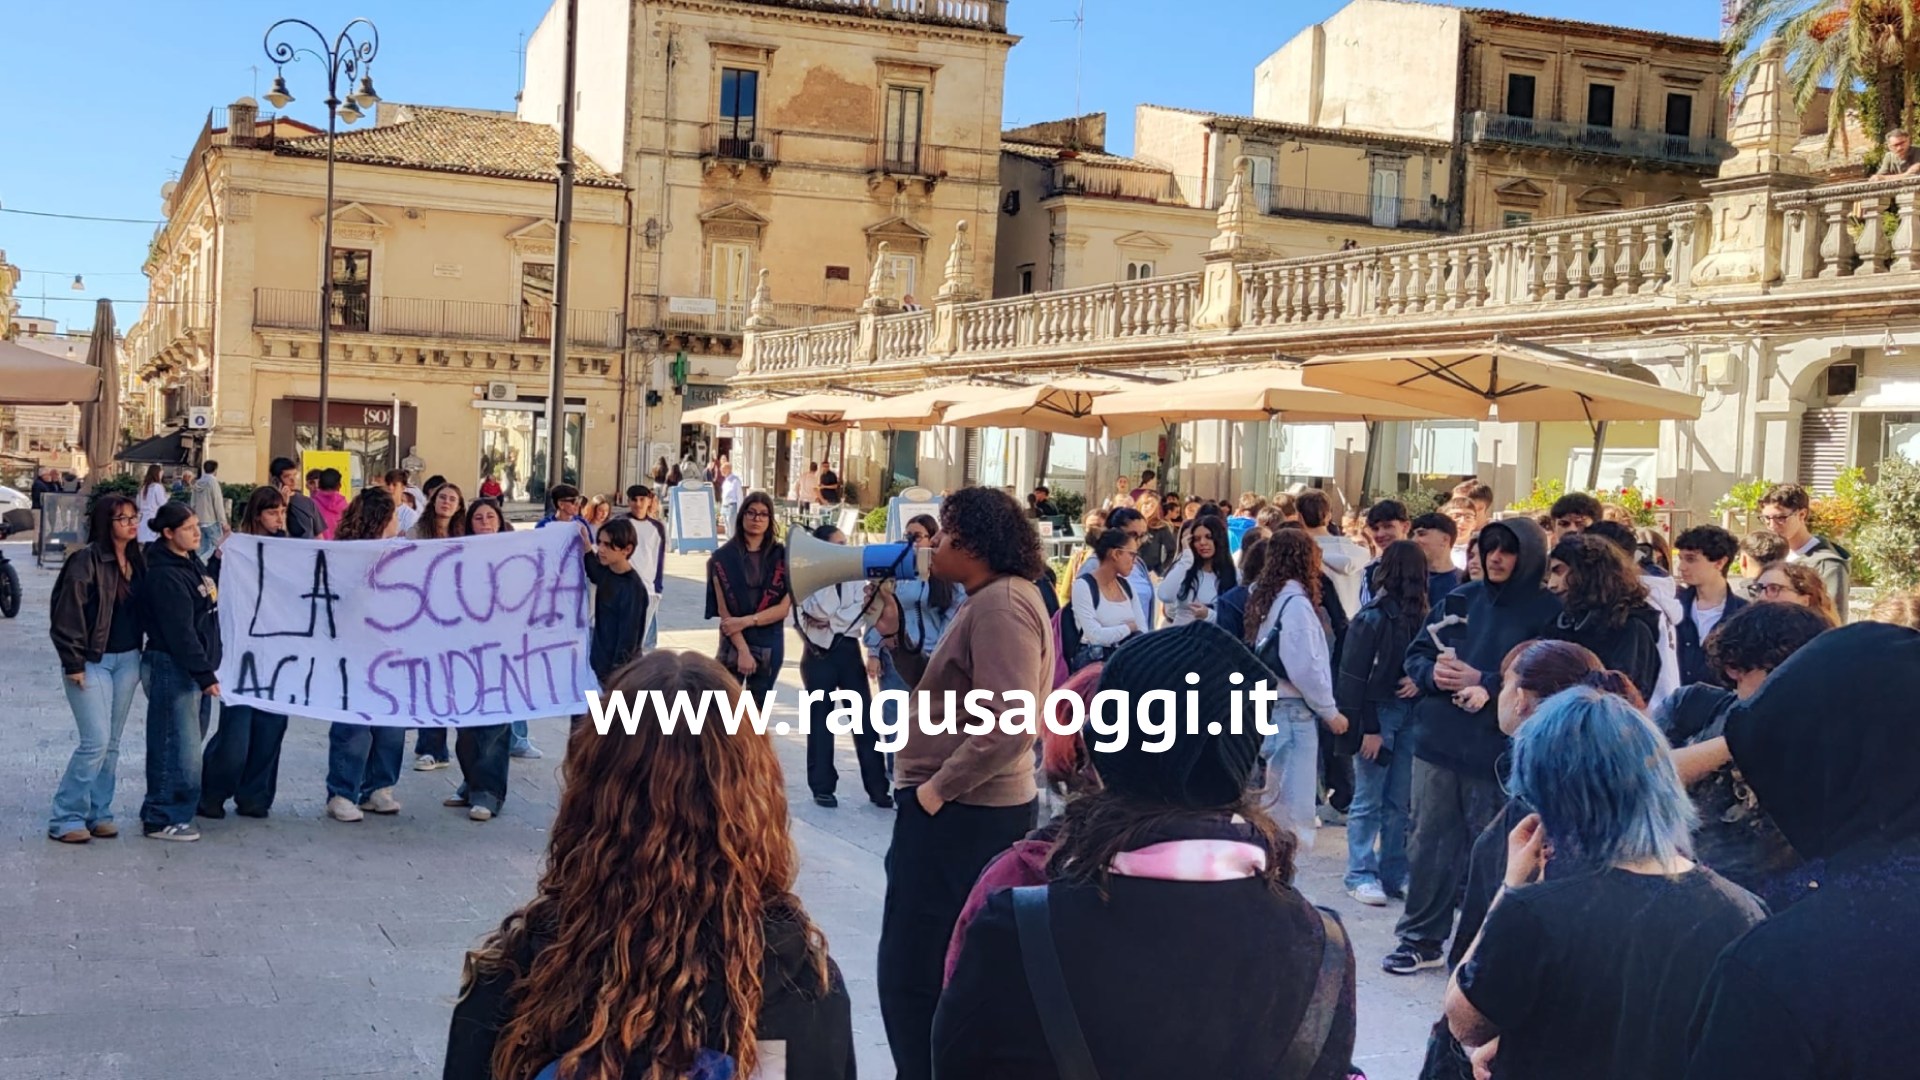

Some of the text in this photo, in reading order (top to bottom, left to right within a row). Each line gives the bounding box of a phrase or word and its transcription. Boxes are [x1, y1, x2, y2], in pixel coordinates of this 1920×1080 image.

[248, 535, 586, 638] LA SCUOLA
[366, 632, 586, 717] STUDENTI
